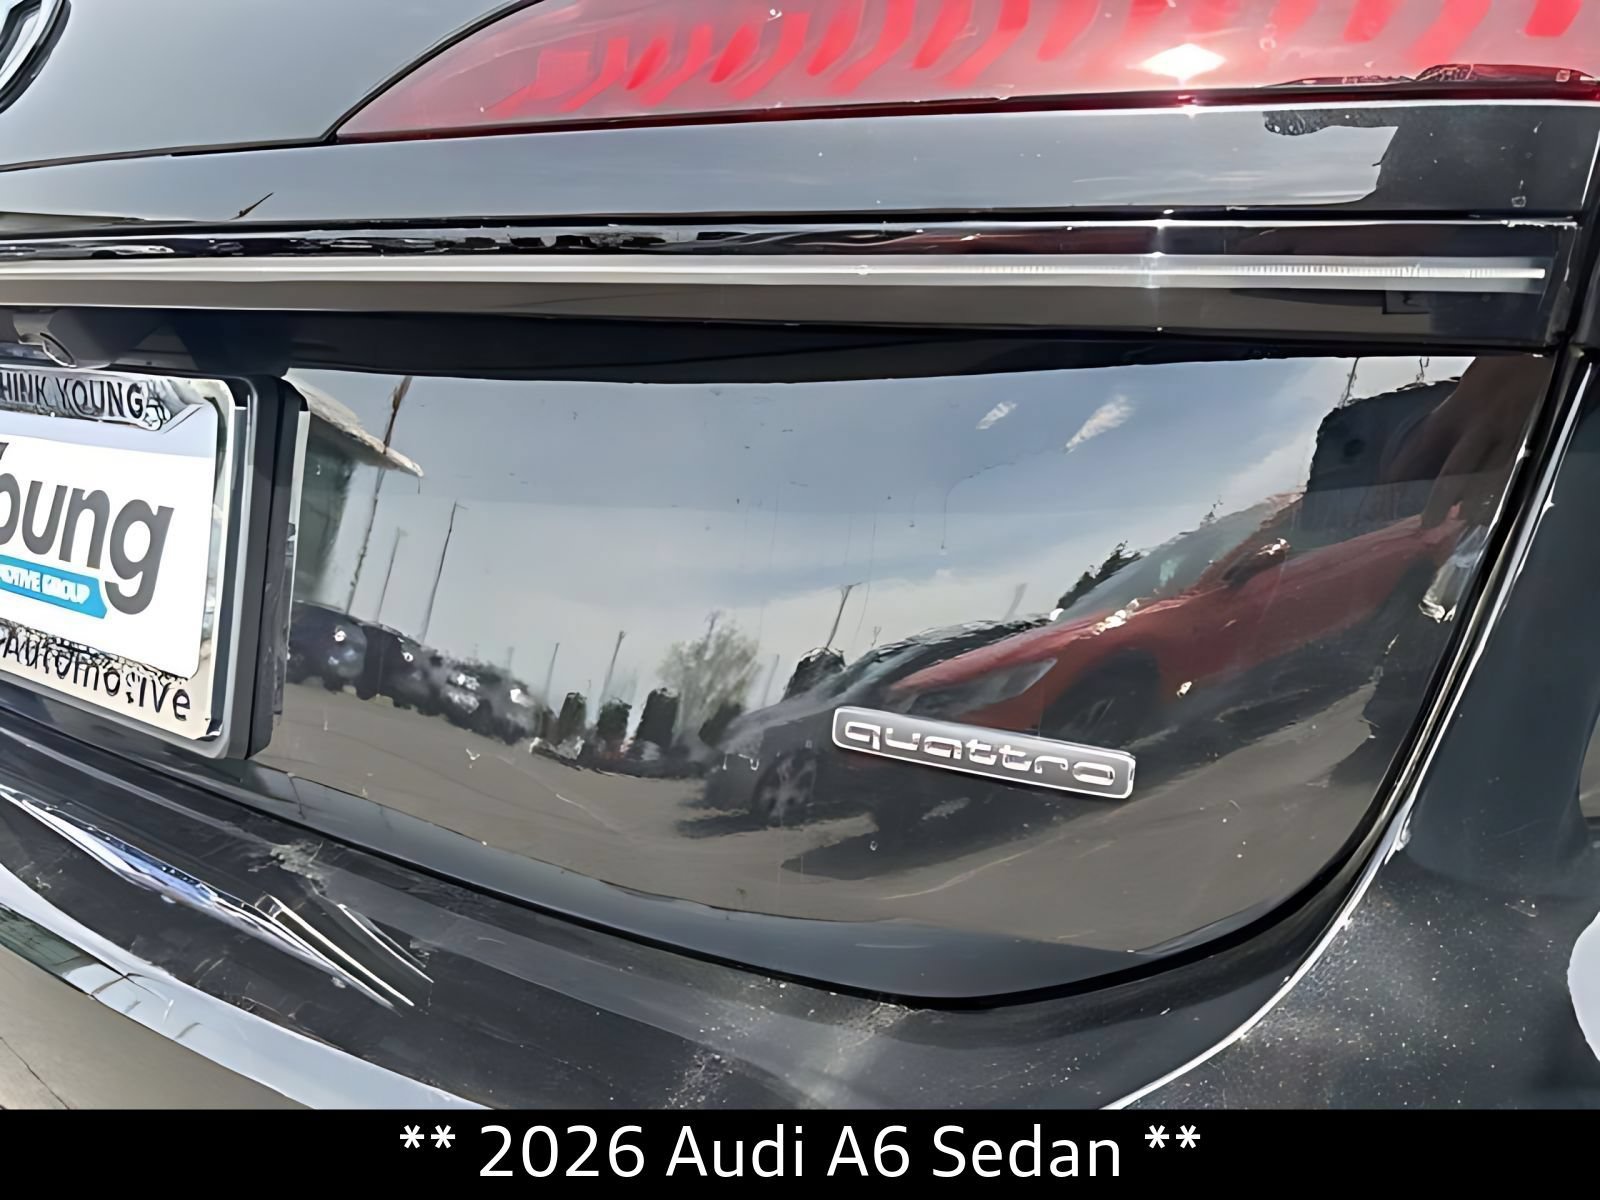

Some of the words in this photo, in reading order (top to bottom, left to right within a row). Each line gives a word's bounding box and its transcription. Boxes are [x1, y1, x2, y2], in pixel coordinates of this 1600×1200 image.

[56, 377, 144, 419] YOUNG
[0, 442, 175, 615] oung
[844, 721, 1116, 787] quattro
